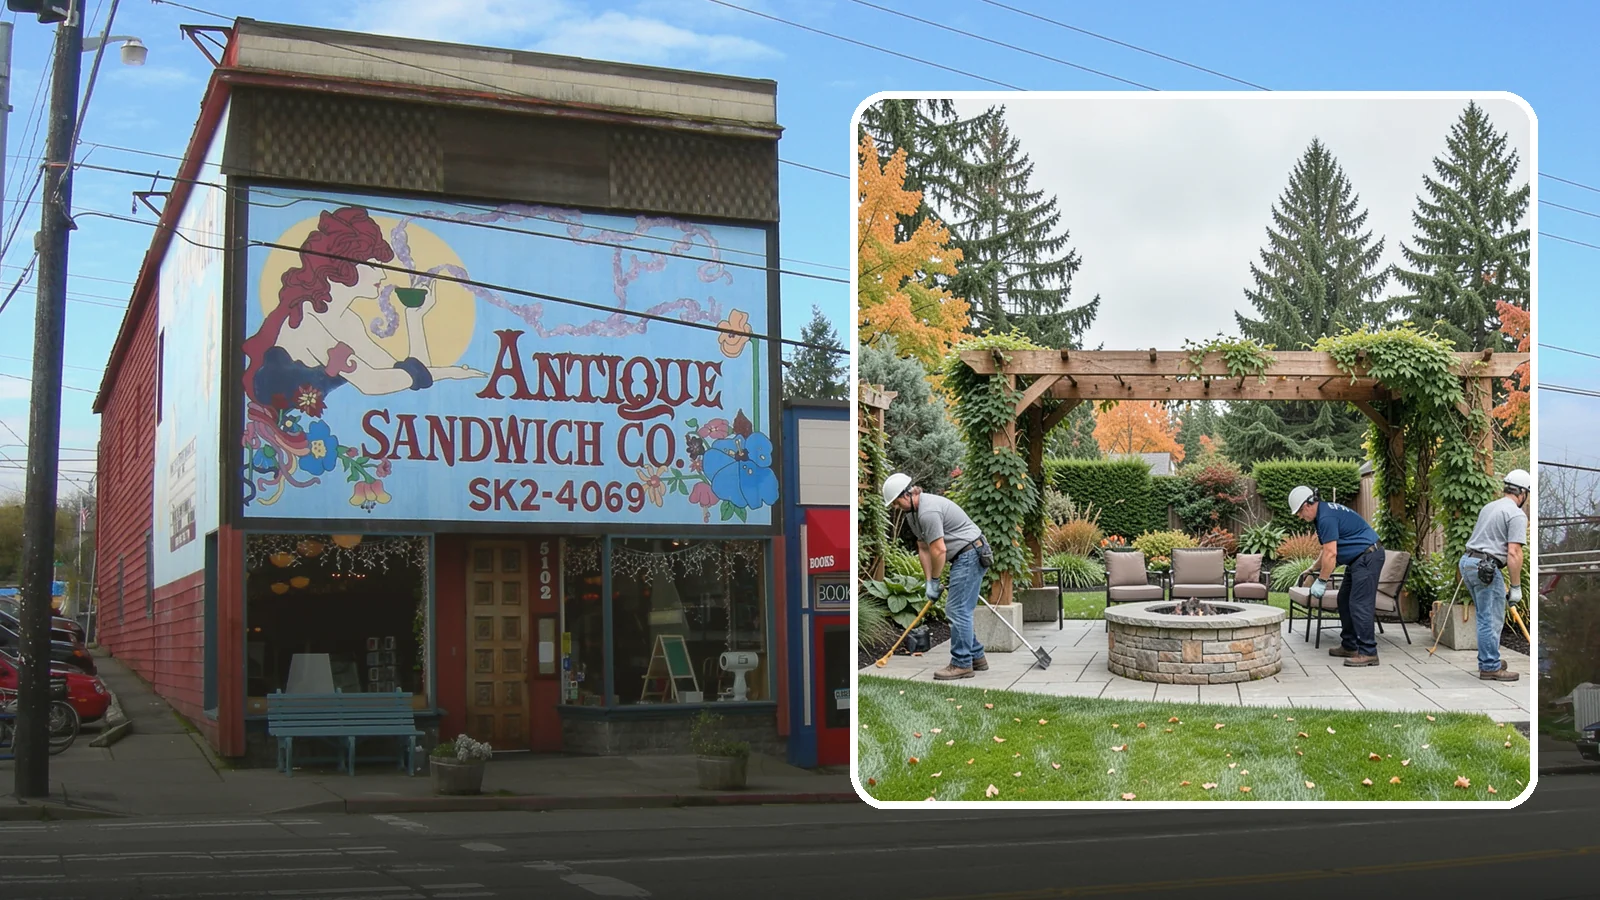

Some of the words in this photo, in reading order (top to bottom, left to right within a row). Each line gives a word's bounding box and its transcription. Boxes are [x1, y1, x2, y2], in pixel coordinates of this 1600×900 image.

[476, 329, 723, 420] ANTIQUE
[361, 408, 604, 467] SANDWICH
[617, 421, 684, 469] CO.
[469, 477, 645, 514] SK2-4069
[540, 542, 552, 600] 5102
[809, 556, 834, 569] BOOKS
